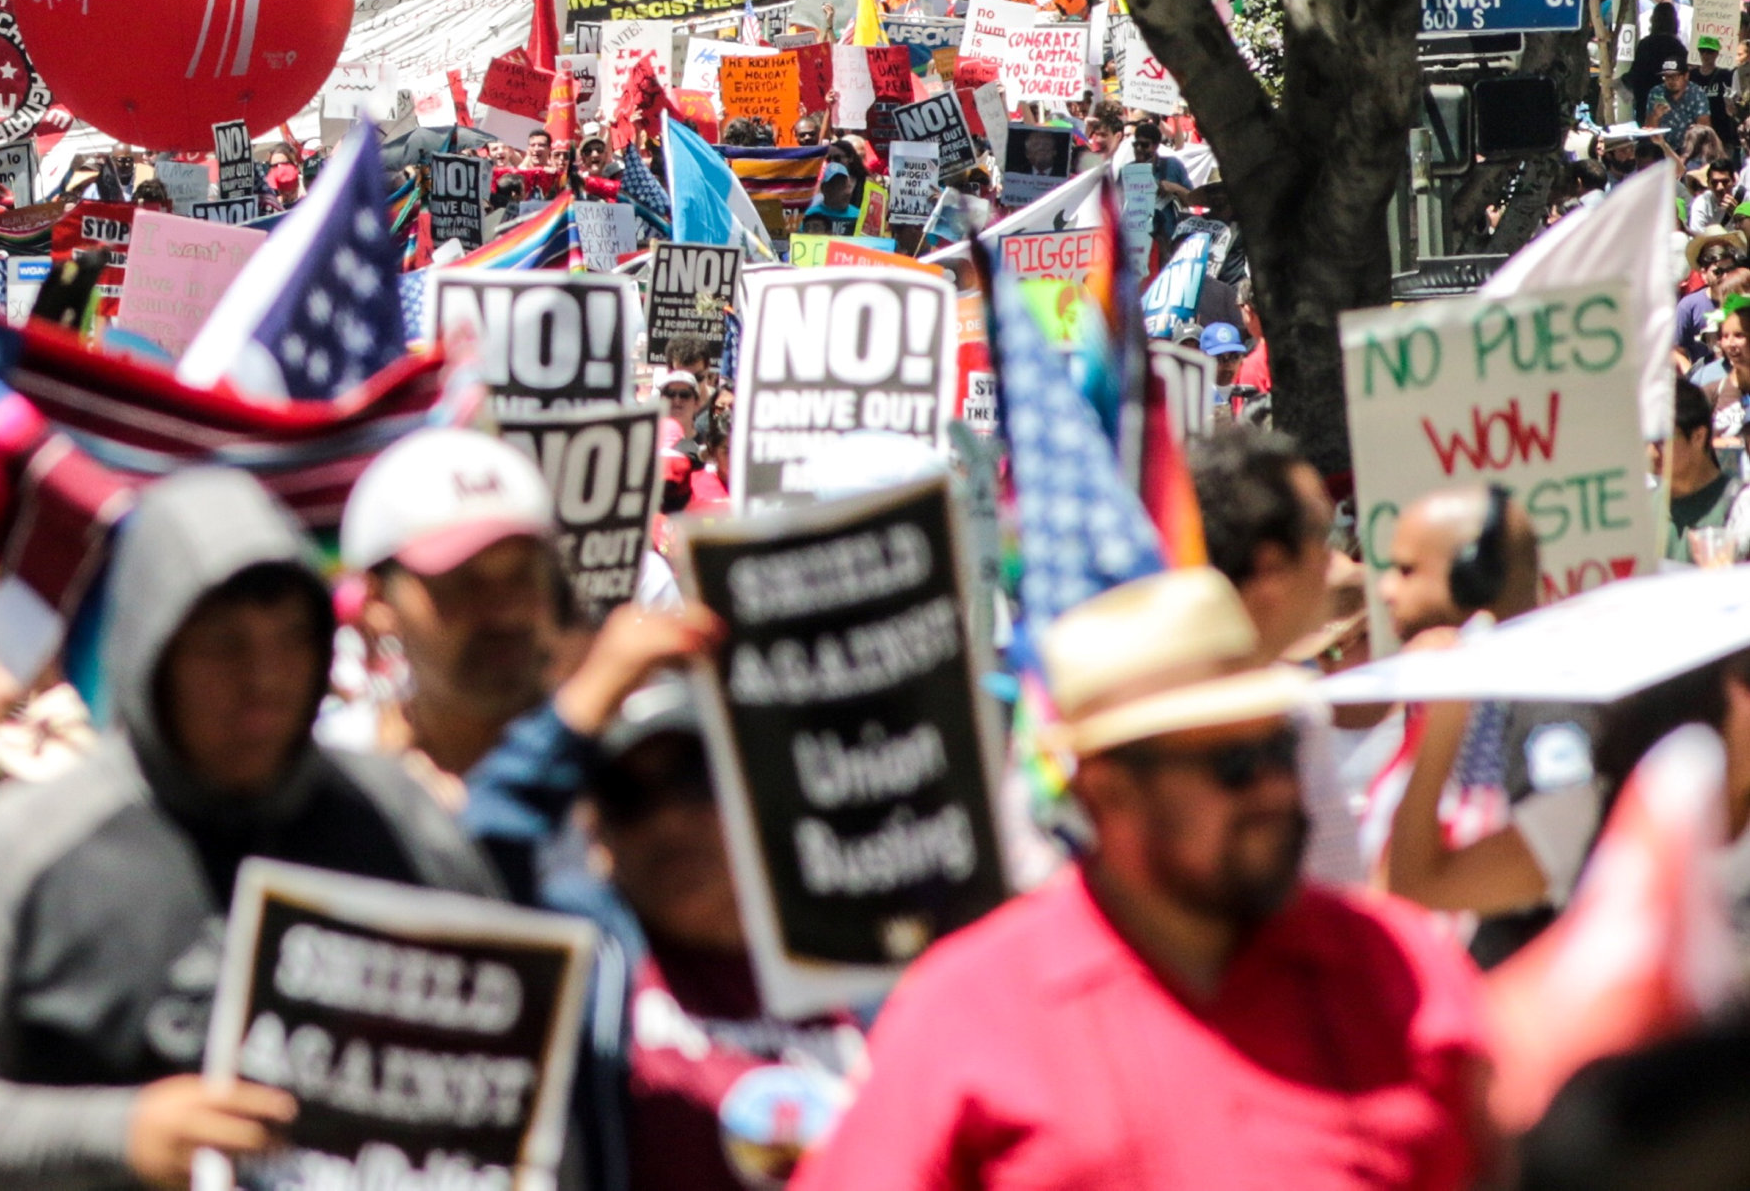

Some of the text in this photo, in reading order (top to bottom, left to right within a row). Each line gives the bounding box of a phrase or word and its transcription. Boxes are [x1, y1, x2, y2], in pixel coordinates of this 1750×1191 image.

[977, 7, 995, 19] no
[1422, 10, 1484, 30] 600 S
[887, 26, 963, 47] AFSCME
[974, 21, 1007, 37] hum
[971, 35, 982, 48] is
[723, 55, 796, 68] THE RICH HAVE
[868, 49, 889, 62] MAY
[745, 70, 787, 79] HOLIDAY
[1005, 62, 1029, 78] YOU
[1034, 62, 1078, 79] PLAYED
[1018, 79, 1082, 97] YOURSELF
[739, 105, 782, 115] PEOPLE
[900, 96, 959, 141] NO!
[218, 124, 250, 162] NO!
[943, 129, 964, 143] OUT
[7, 152, 21, 166] lo
[903, 161, 928, 171] BUILD
[235, 162, 251, 177] OUT
[432, 159, 479, 199] NO!
[905, 180, 922, 188] NOT
[460, 200, 479, 216] OUT
[578, 206, 614, 220] SMASH
[83, 217, 129, 242] STOP
[580, 223, 617, 238] RACISM
[583, 240, 621, 254] SEXISM
[655, 248, 736, 295] ¡NO!
[441, 286, 618, 390] NO!
[758, 283, 938, 387] NO!
[1363, 293, 1624, 400] NO PUES
[974, 379, 996, 396] ST
[753, 388, 936, 433] DRIVE OUT
[966, 407, 991, 420] THE
[1420, 391, 1561, 477] WOW
[1366, 466, 1632, 571] CSTE
[581, 527, 641, 567] OUT
[725, 521, 932, 629] SHIELD
[725, 599, 964, 706] AGAINST
[791, 720, 949, 811] Union
[791, 806, 974, 898] Busting
[272, 920, 524, 1037] SHIELD
[240, 1009, 538, 1132] AGAINST
